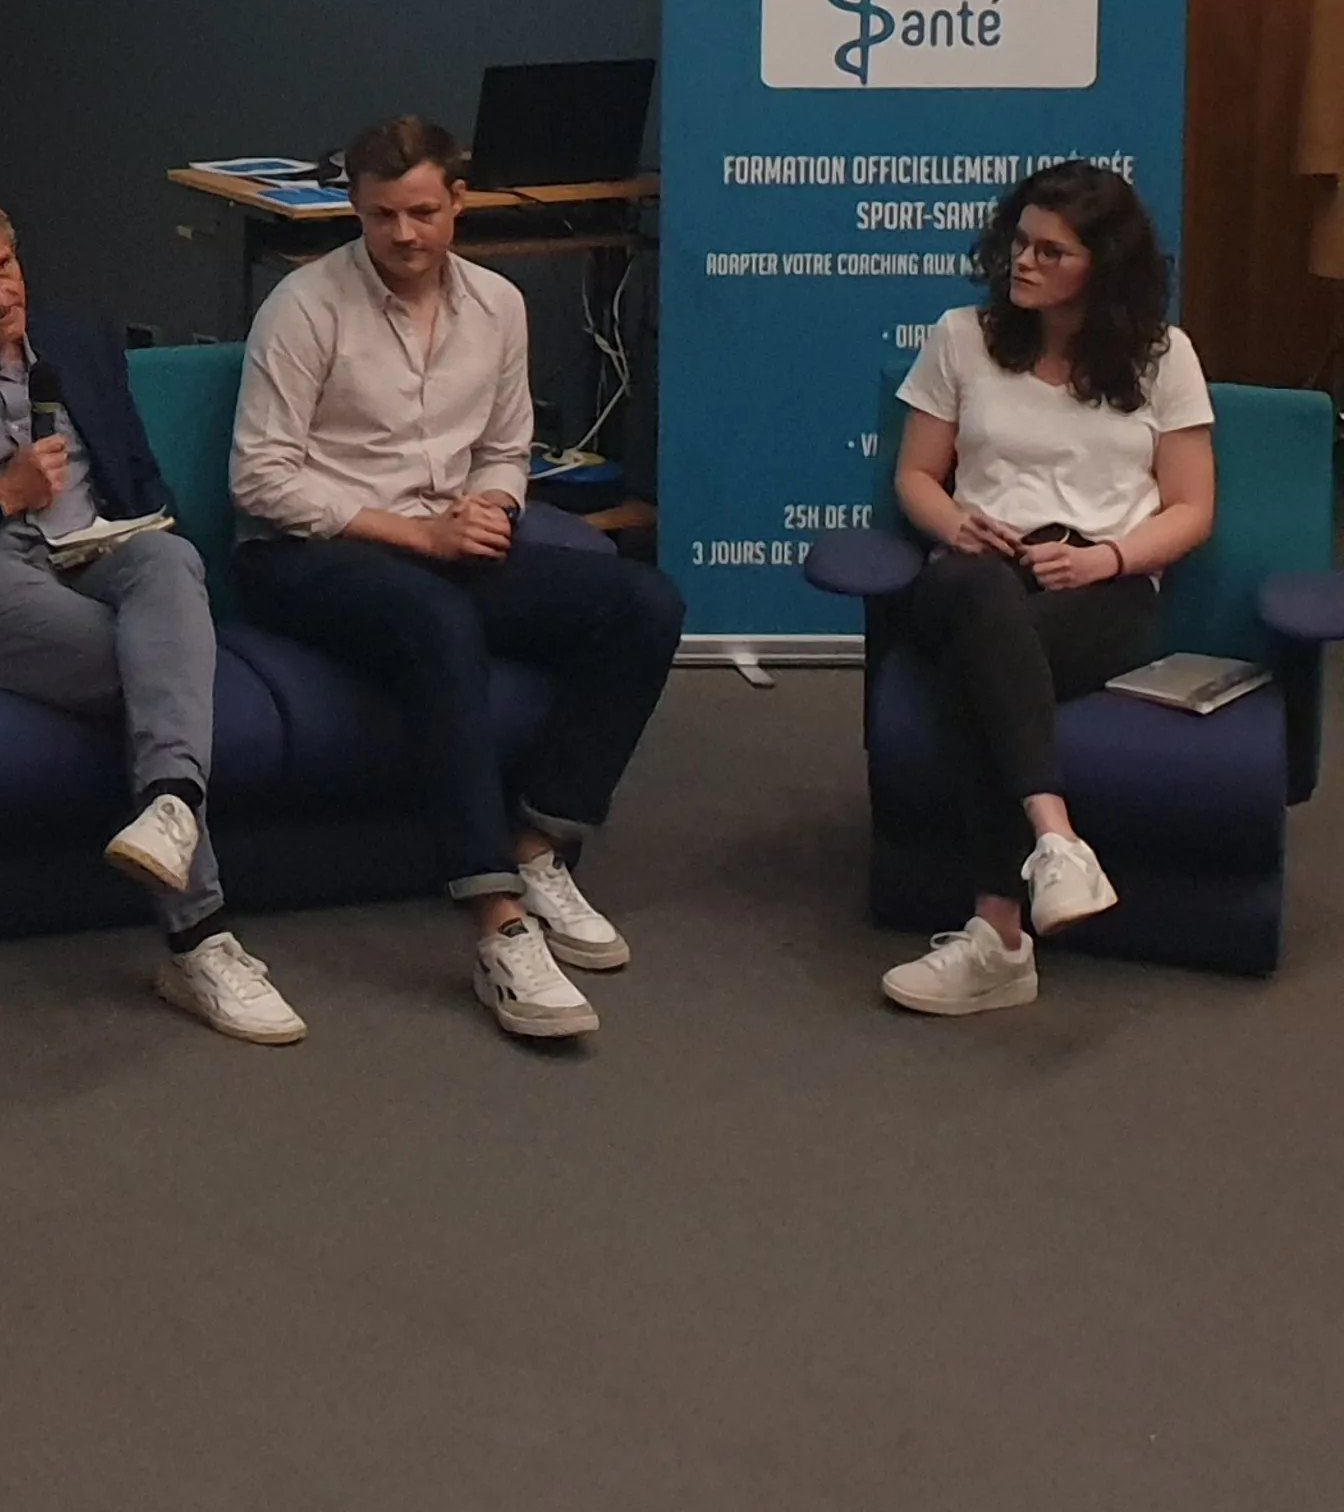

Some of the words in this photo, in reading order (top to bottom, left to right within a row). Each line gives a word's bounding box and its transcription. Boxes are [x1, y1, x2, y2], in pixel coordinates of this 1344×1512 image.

[724, 156, 845, 185] FORMATION
[853, 155, 1018, 185] OFFICIELLEMENT
[857, 197, 1000, 230] SPORT-SANTÉ
[707, 254, 778, 276] ADAPTER
[783, 253, 832, 276] VOTRE
[837, 253, 918, 276] COACHING
[924, 254, 955, 276] AUX
[784, 504, 819, 529] 25H
[825, 504, 848, 528] DE
[692, 541, 703, 565] 3
[709, 540, 766, 565] JOURS
[771, 541, 792, 565] DE
